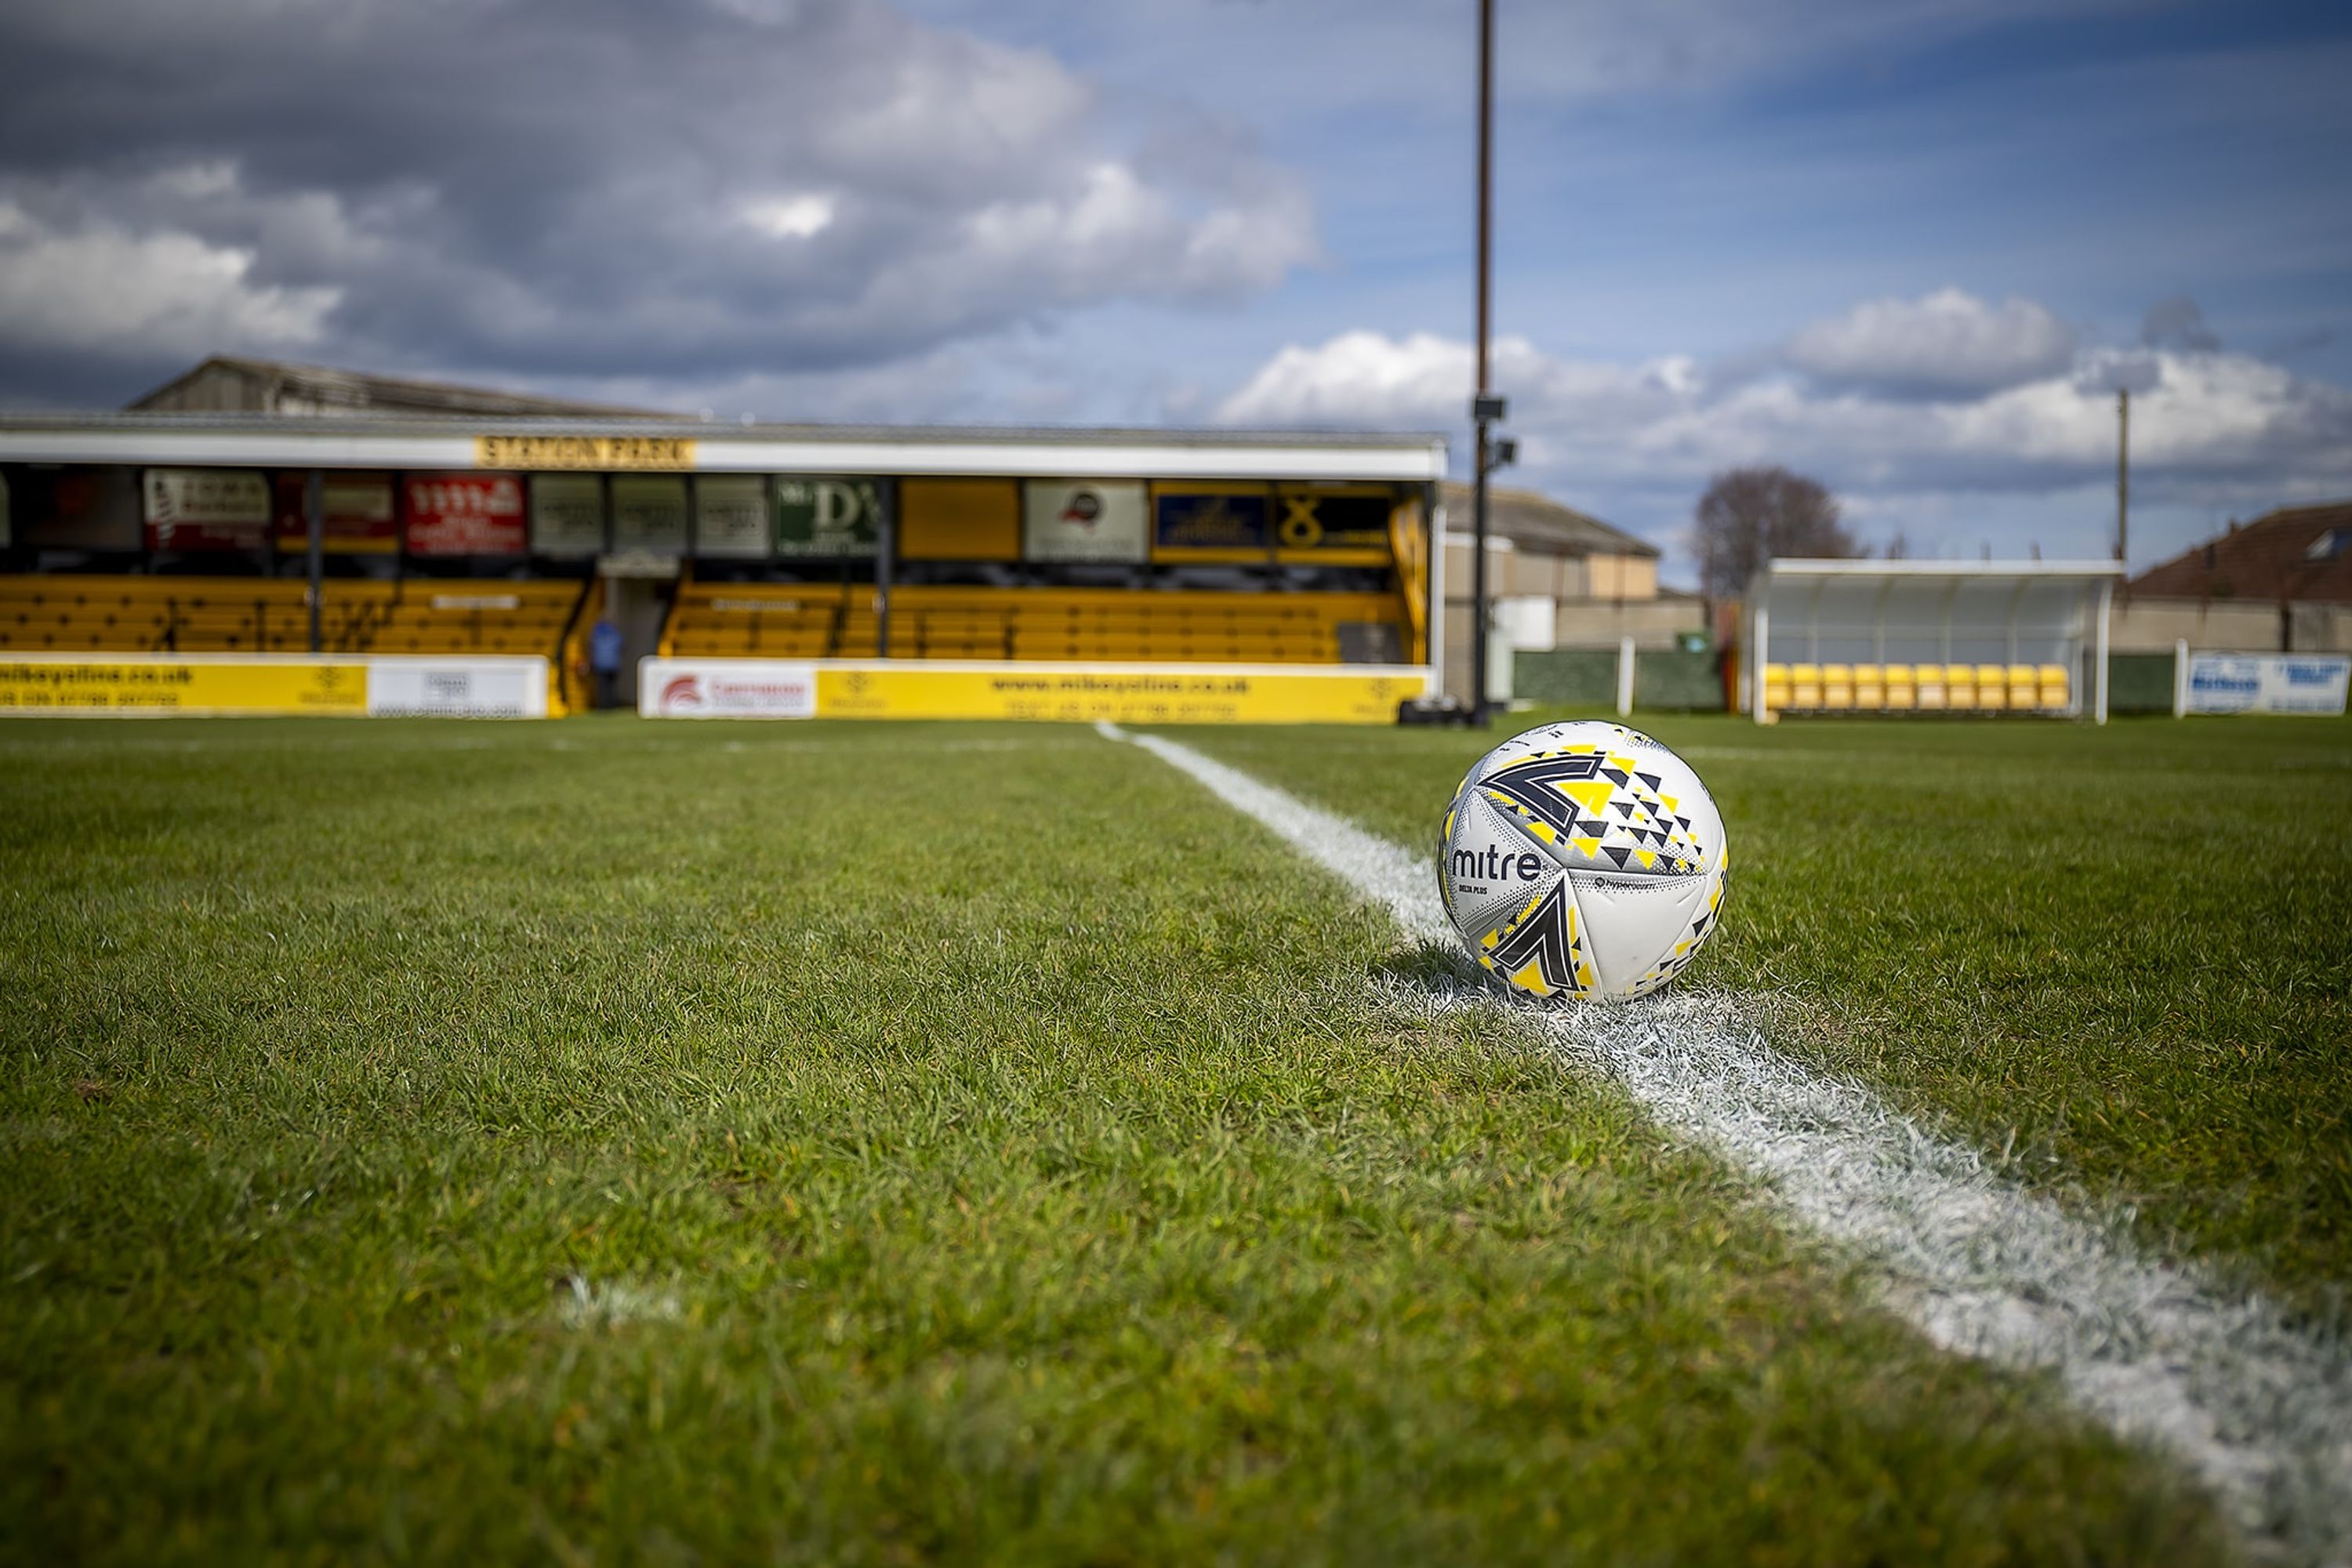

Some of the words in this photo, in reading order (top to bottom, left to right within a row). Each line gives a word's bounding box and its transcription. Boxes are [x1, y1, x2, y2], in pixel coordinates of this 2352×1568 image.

[1452, 844, 1541, 881] mitre
[1459, 884, 1472, 893] DELTA
[1473, 886, 1488, 895] PLUS
